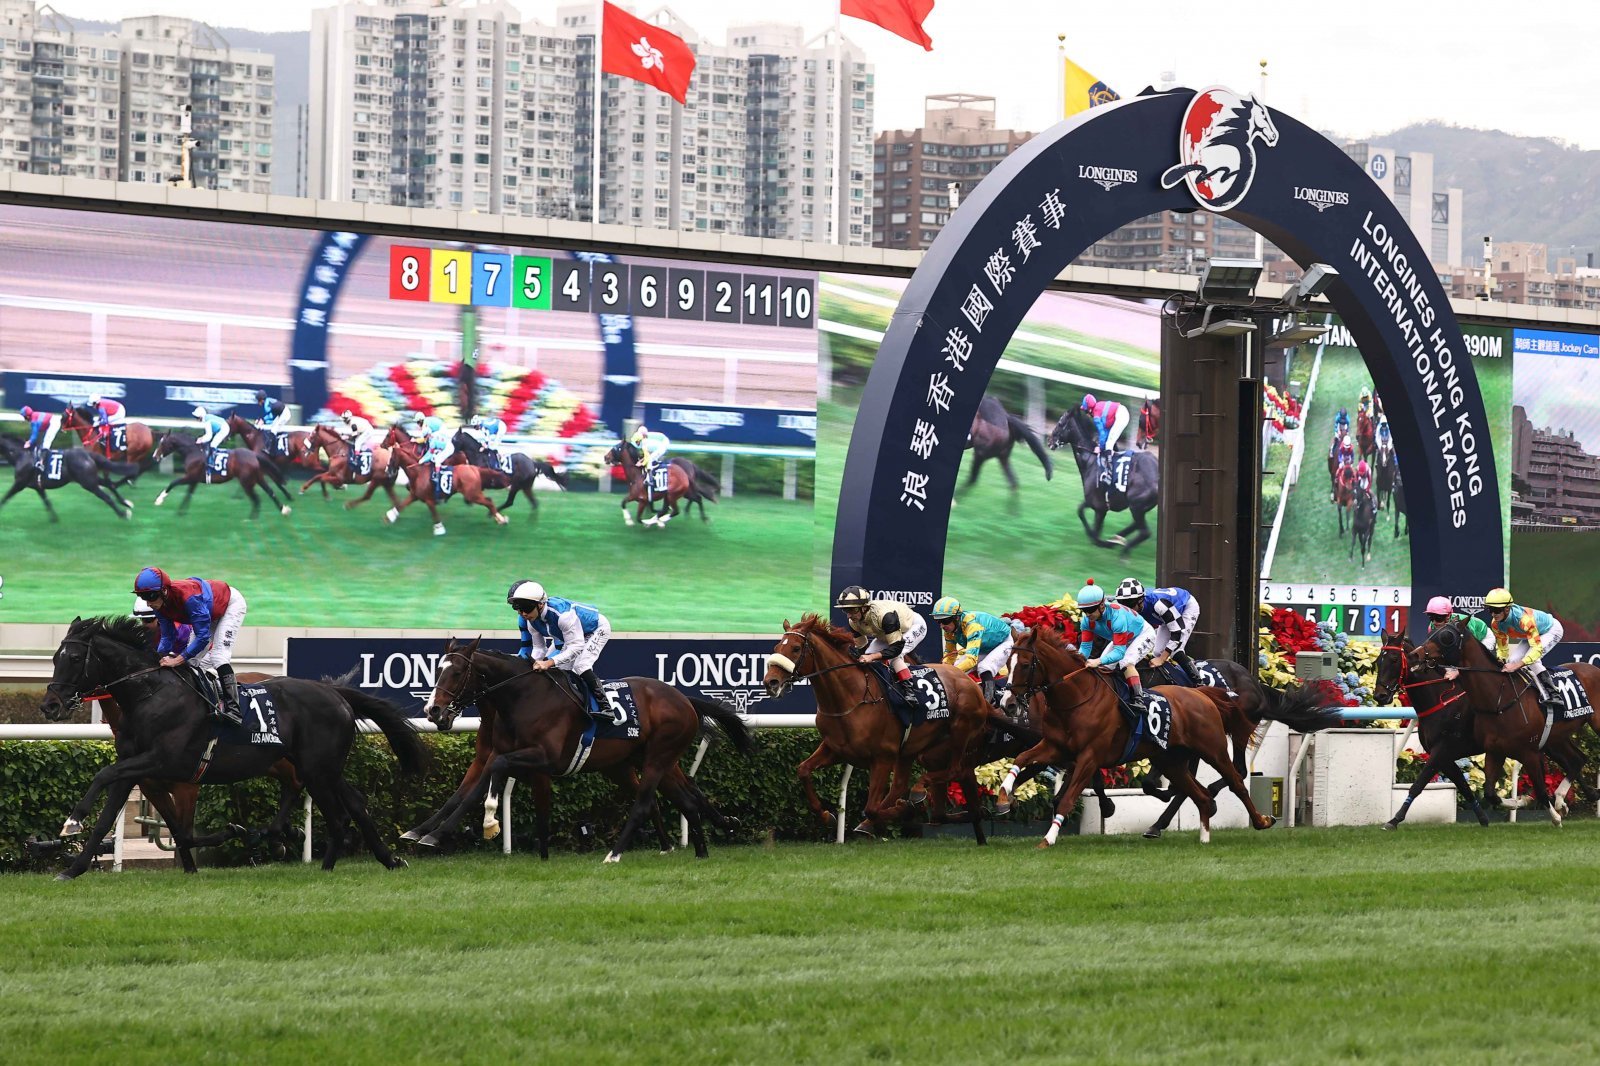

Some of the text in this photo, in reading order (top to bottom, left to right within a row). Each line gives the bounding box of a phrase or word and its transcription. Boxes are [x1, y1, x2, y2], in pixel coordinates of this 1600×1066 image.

[1078, 165, 1138, 183] LONGINES
[1294, 186, 1349, 205] LONGINES
[401, 256, 811, 319] 8 1 7 5 4 3 6 9 2 11 10
[900, 188, 1067, 512] 浪琴香港國際賽事
[1362, 210, 1483, 497] LONGINES HONG KONG
[1561, 343, 1582, 355] Jockey
[1583, 344, 1598, 354] Cam
[1349, 237, 1467, 529] INTERNATIONAL RACES
[1264, 586, 1399, 603] 2 3 4 5 6 7 8
[1448, 596, 1486, 608] LONGIN
[1326, 608, 1338, 632] 4
[1348, 608, 1360, 632] 7
[1369, 609, 1380, 633] 3
[1390, 609, 1400, 633] 1
[360, 652, 446, 689] LON
[605, 690, 628, 726] 5
[917, 678, 940, 711] 3
[1558, 677, 1582, 710] 11
[249, 697, 268, 733] 1
[1147, 701, 1162, 736] 6
[251, 733, 261, 744] LOS
